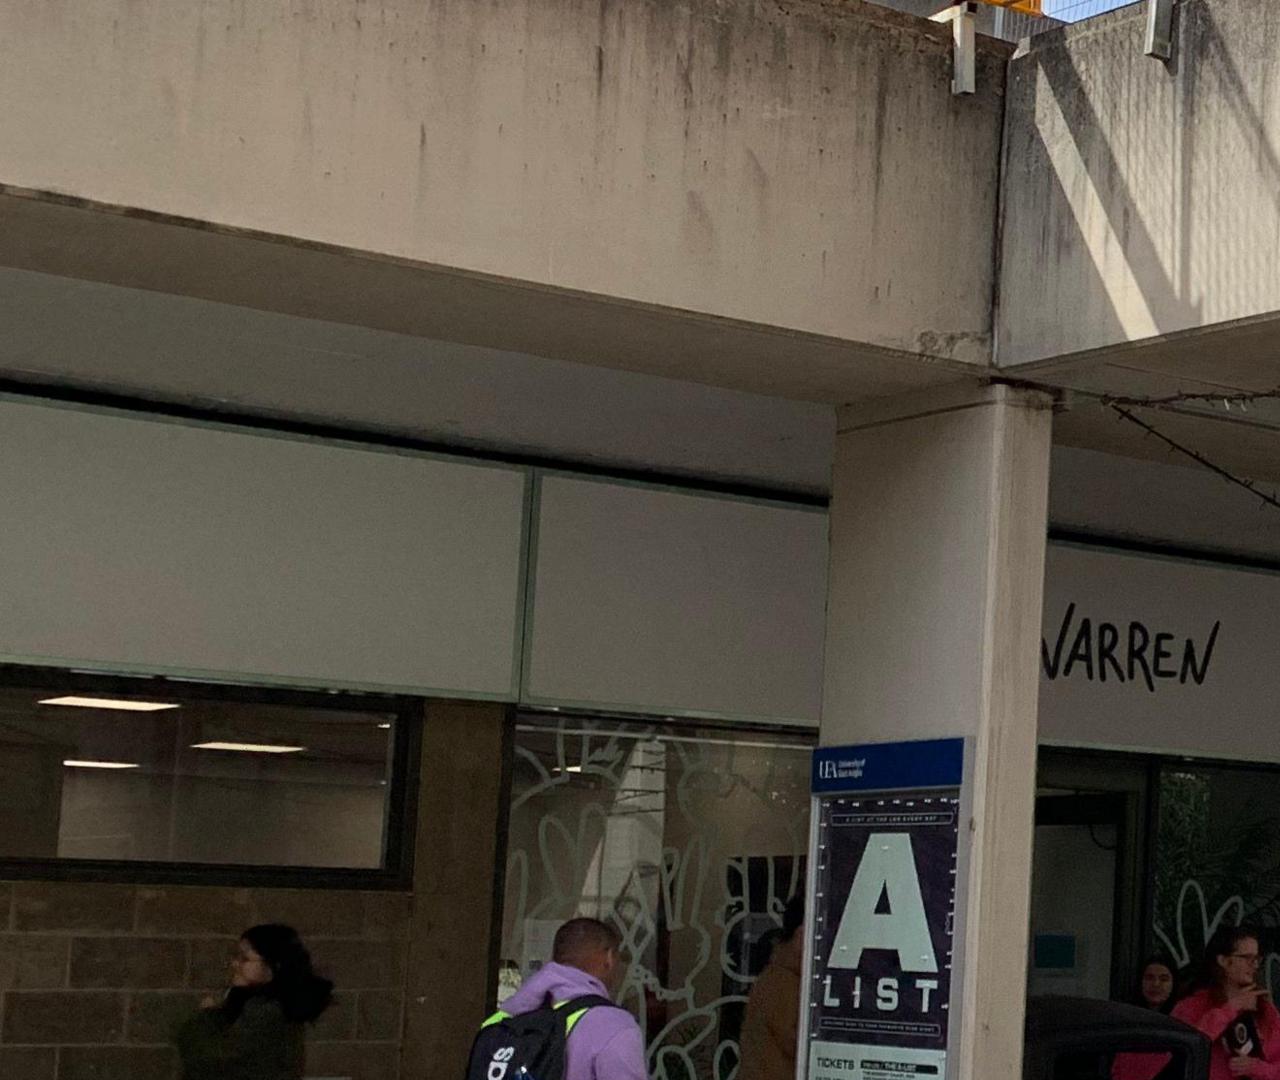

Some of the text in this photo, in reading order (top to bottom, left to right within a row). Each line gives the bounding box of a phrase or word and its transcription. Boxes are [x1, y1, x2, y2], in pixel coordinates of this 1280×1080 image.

[827, 833, 938, 973] A
[822, 975, 939, 1014] LIST
[816, 1057, 855, 1071] TICKETS
